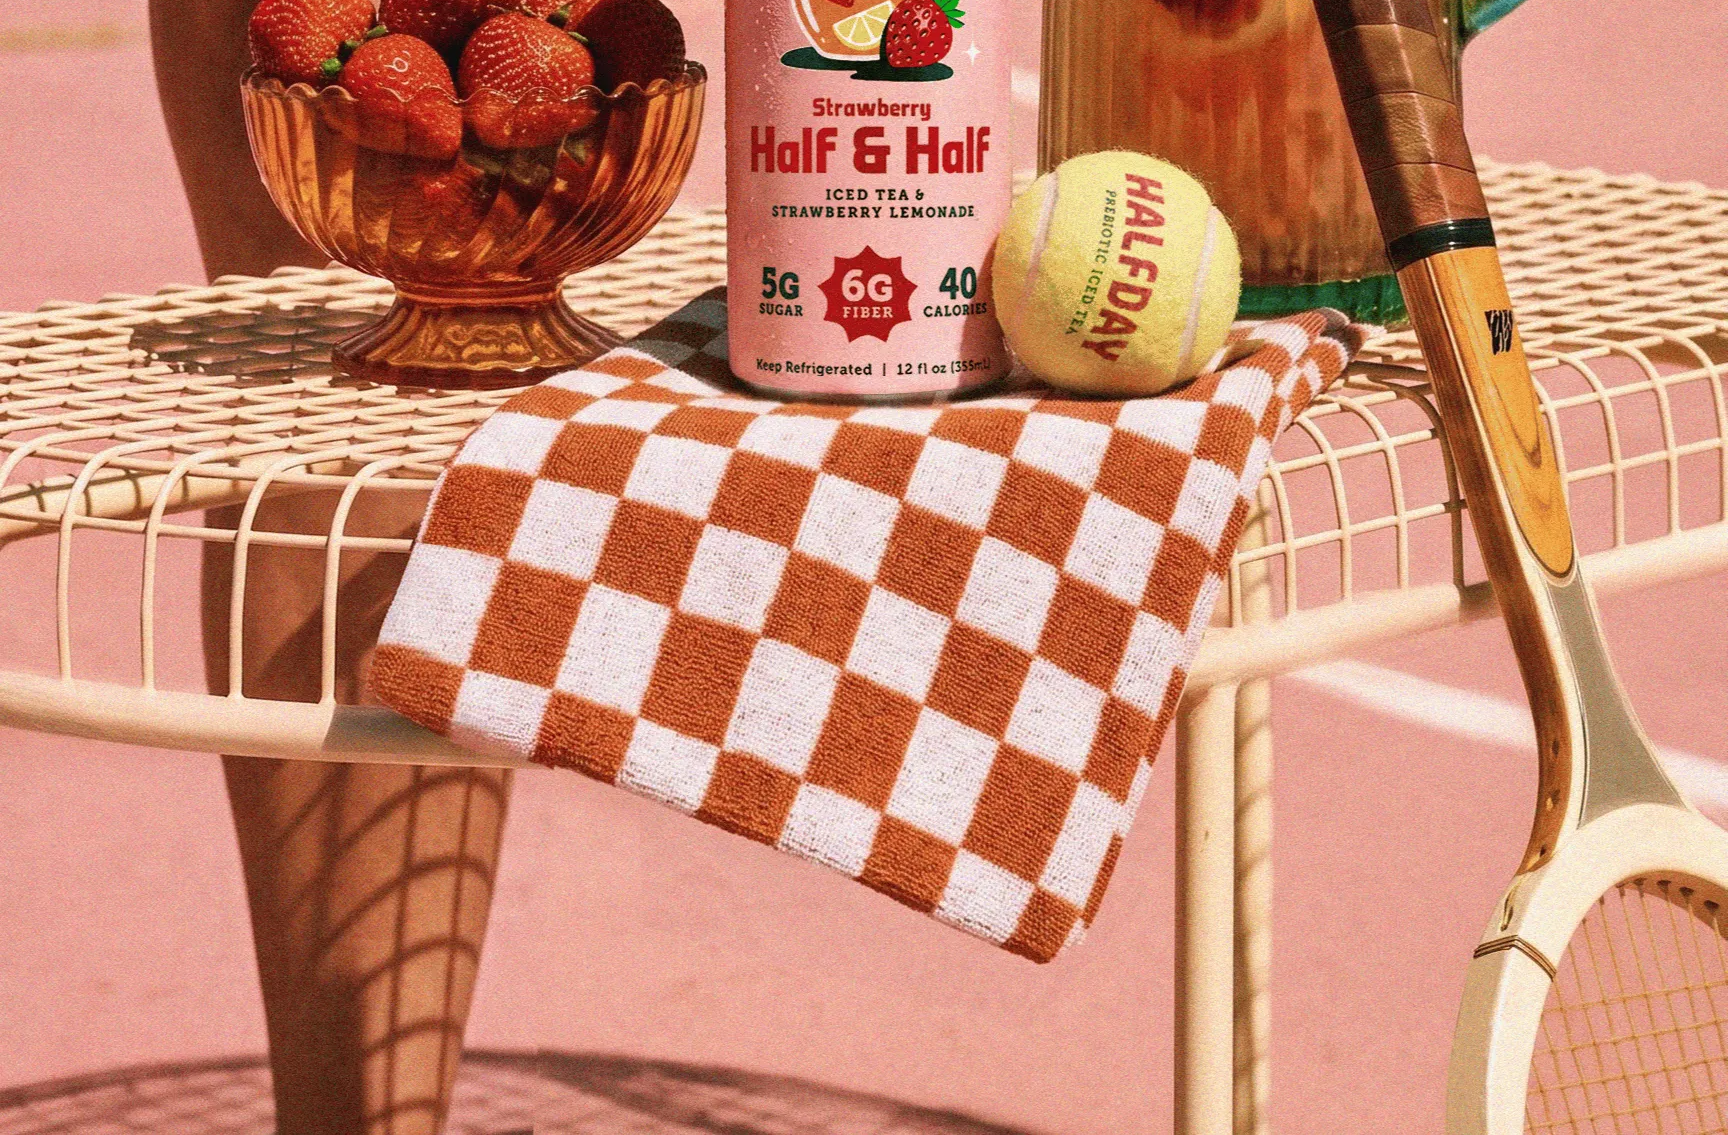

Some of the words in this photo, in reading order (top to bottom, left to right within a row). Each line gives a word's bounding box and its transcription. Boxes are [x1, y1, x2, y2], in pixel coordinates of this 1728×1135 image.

[812, 98, 932, 121] Strawberry
[751, 125, 838, 174] Half
[853, 126, 891, 174] &
[906, 126, 991, 174] Half
[825, 188, 869, 201] ICED
[875, 188, 909, 201] TEA
[915, 188, 925, 201] &
[772, 205, 882, 218] STRAWBERRY
[889, 205, 975, 218] LEMONADE
[1094, 189, 1118, 264] PREBIOTIC
[1081, 173, 1166, 362] HALFDAY
[761, 266, 800, 300] 5G
[841, 268, 893, 302] 6G
[939, 266, 977, 300] 40
[1081, 269, 1104, 304] ICED
[759, 302, 803, 317] SUGAR
[842, 306, 893, 318] FIBER
[923, 302, 988, 318] CALORIES
[1065, 310, 1088, 335] TEA
[756, 358, 782, 374] Keep
[786, 360, 872, 377] Refrigerated
[897, 363, 912, 375] 12
[917, 362, 928, 374] fl
[931, 364, 947, 374] oz
